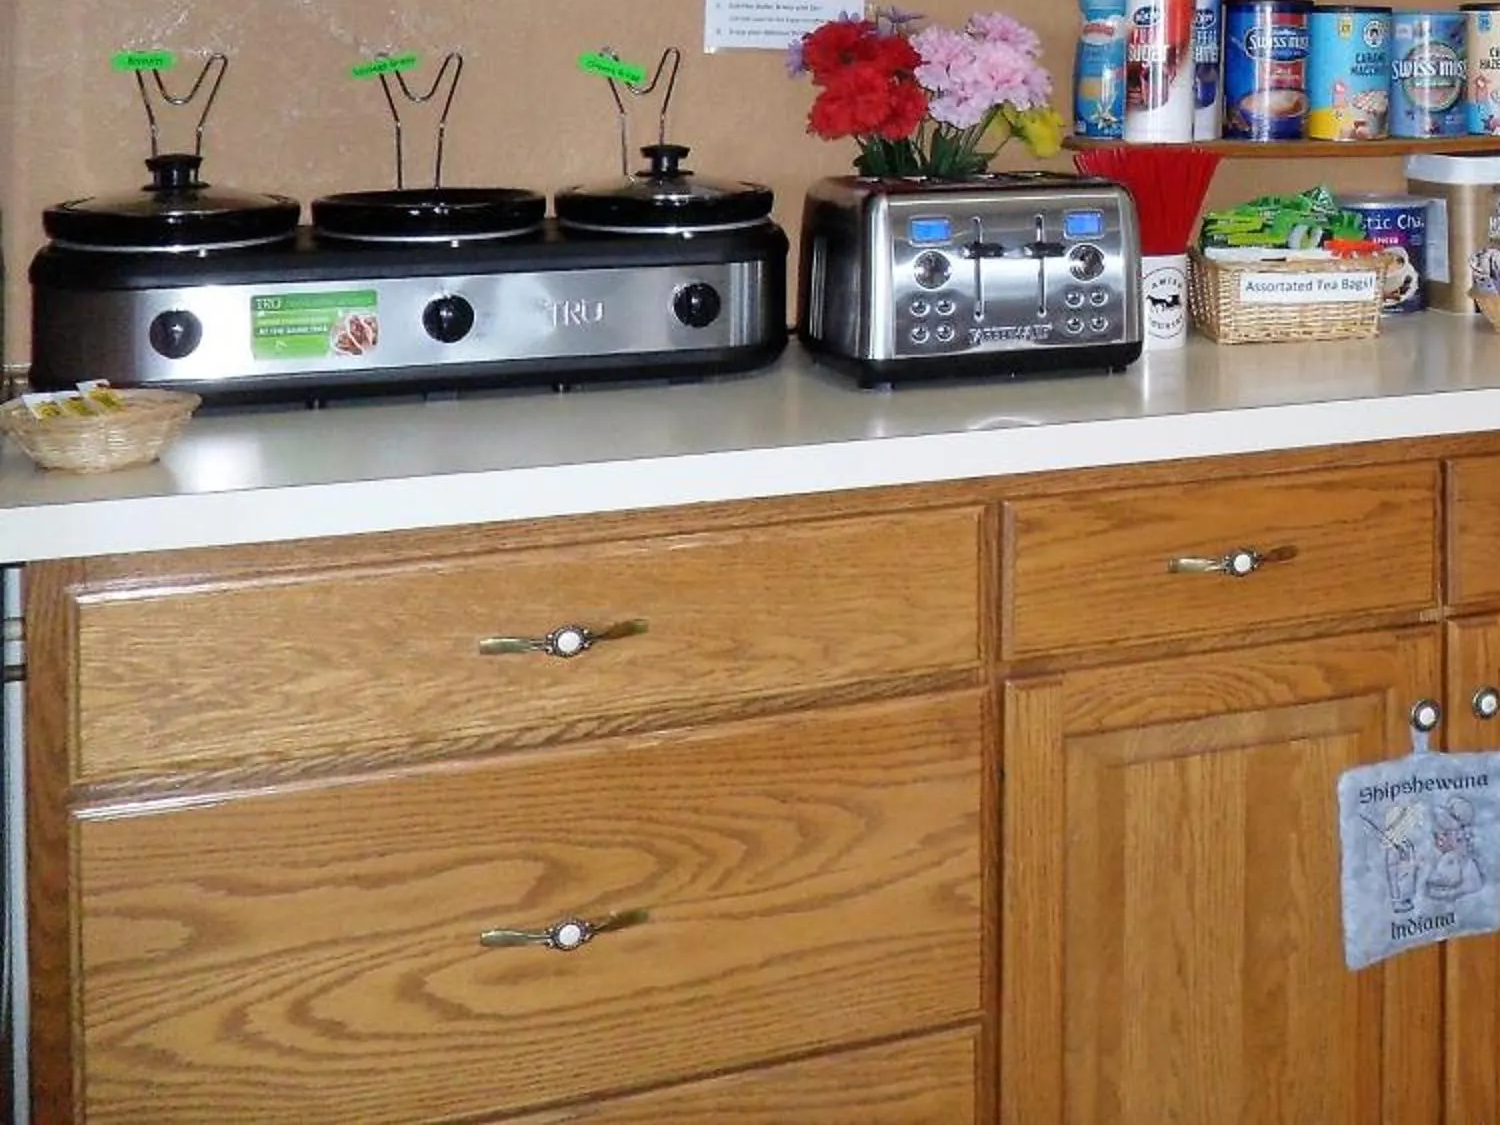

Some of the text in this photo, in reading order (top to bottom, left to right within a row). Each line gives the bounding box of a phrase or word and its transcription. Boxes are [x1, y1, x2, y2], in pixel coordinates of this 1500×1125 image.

[1316, 278, 1338, 291] Tea
[1359, 773, 1489, 805] Shipshewana
[1391, 911, 1456, 940] Indiana
